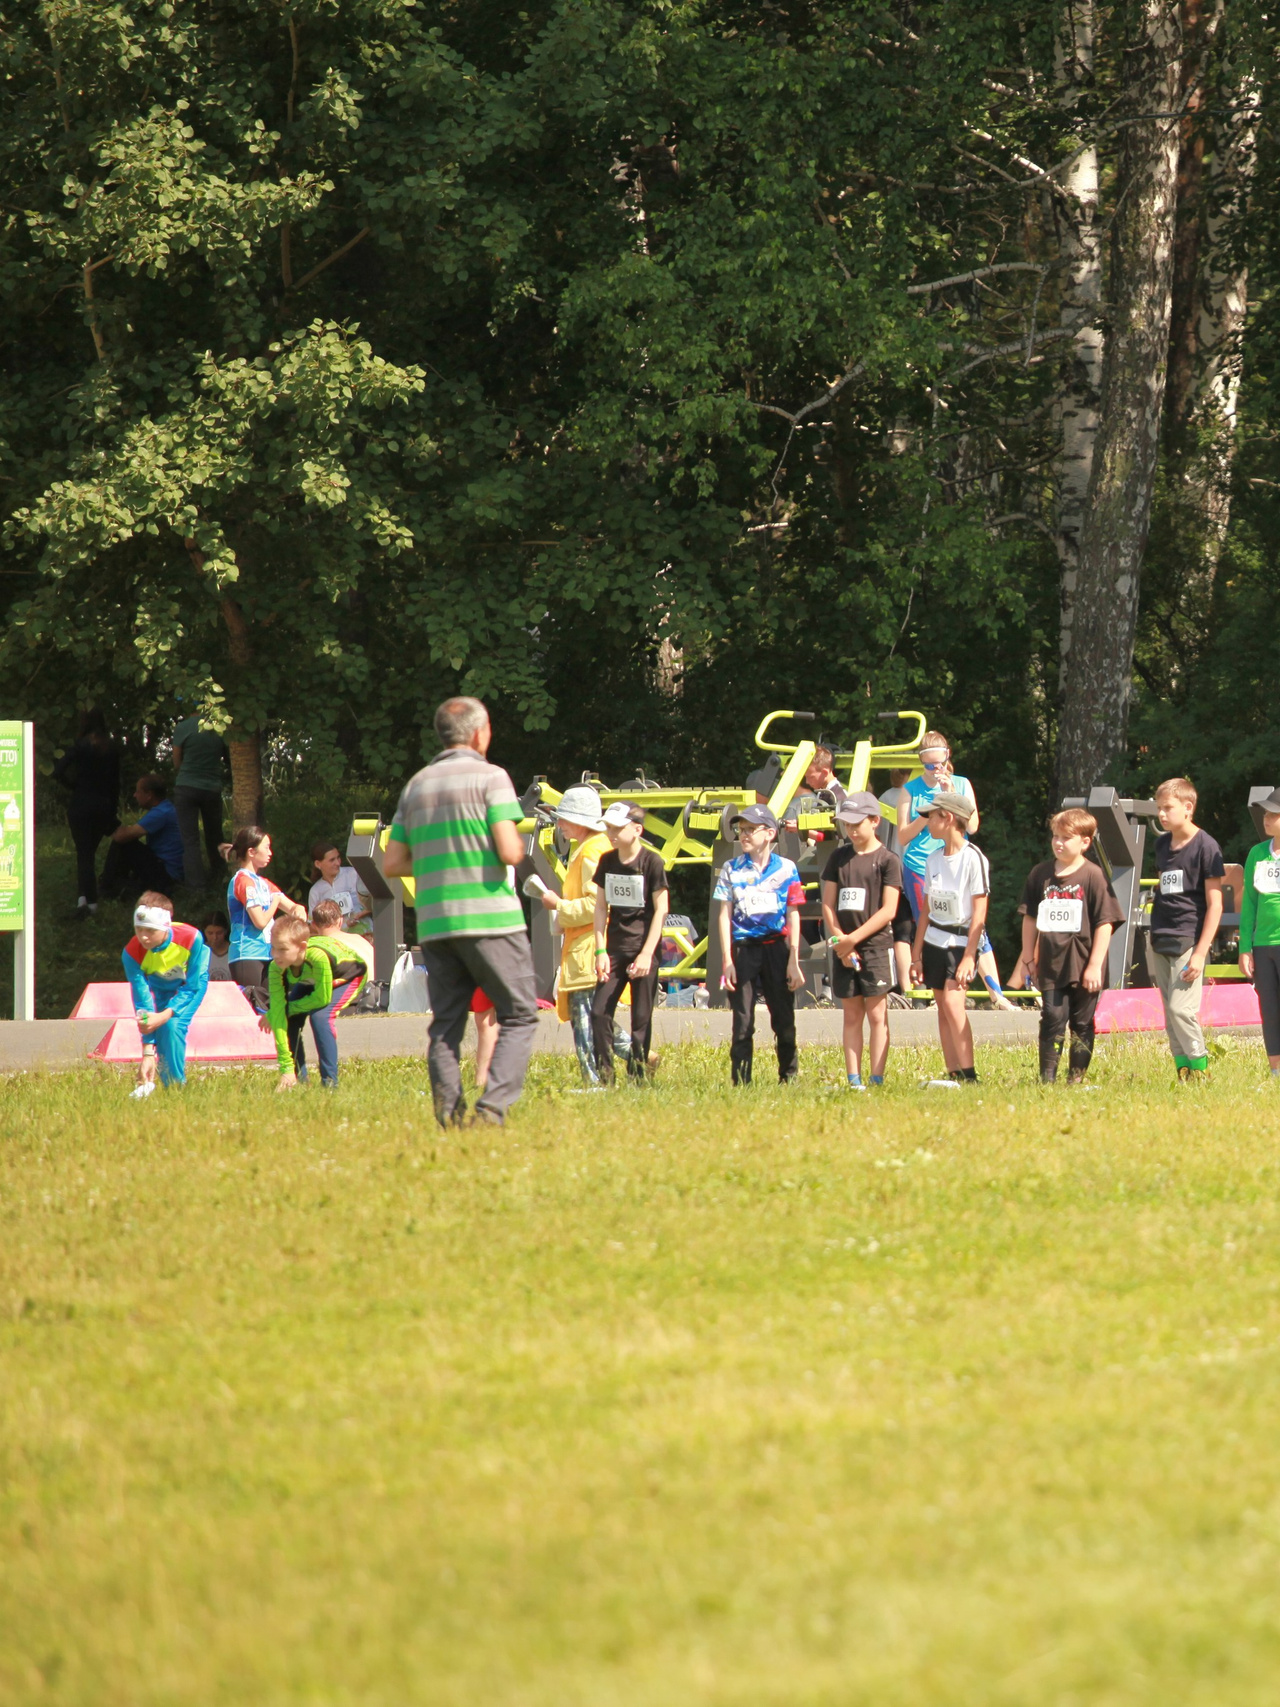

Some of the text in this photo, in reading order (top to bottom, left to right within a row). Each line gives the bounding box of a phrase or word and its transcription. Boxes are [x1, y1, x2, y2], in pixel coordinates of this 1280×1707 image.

[1162, 873, 1178, 886] 659
[613, 885, 632, 897] 635
[841, 890, 857, 901] 633
[933, 900, 948, 912] 648
[1049, 910, 1070, 921] 650
